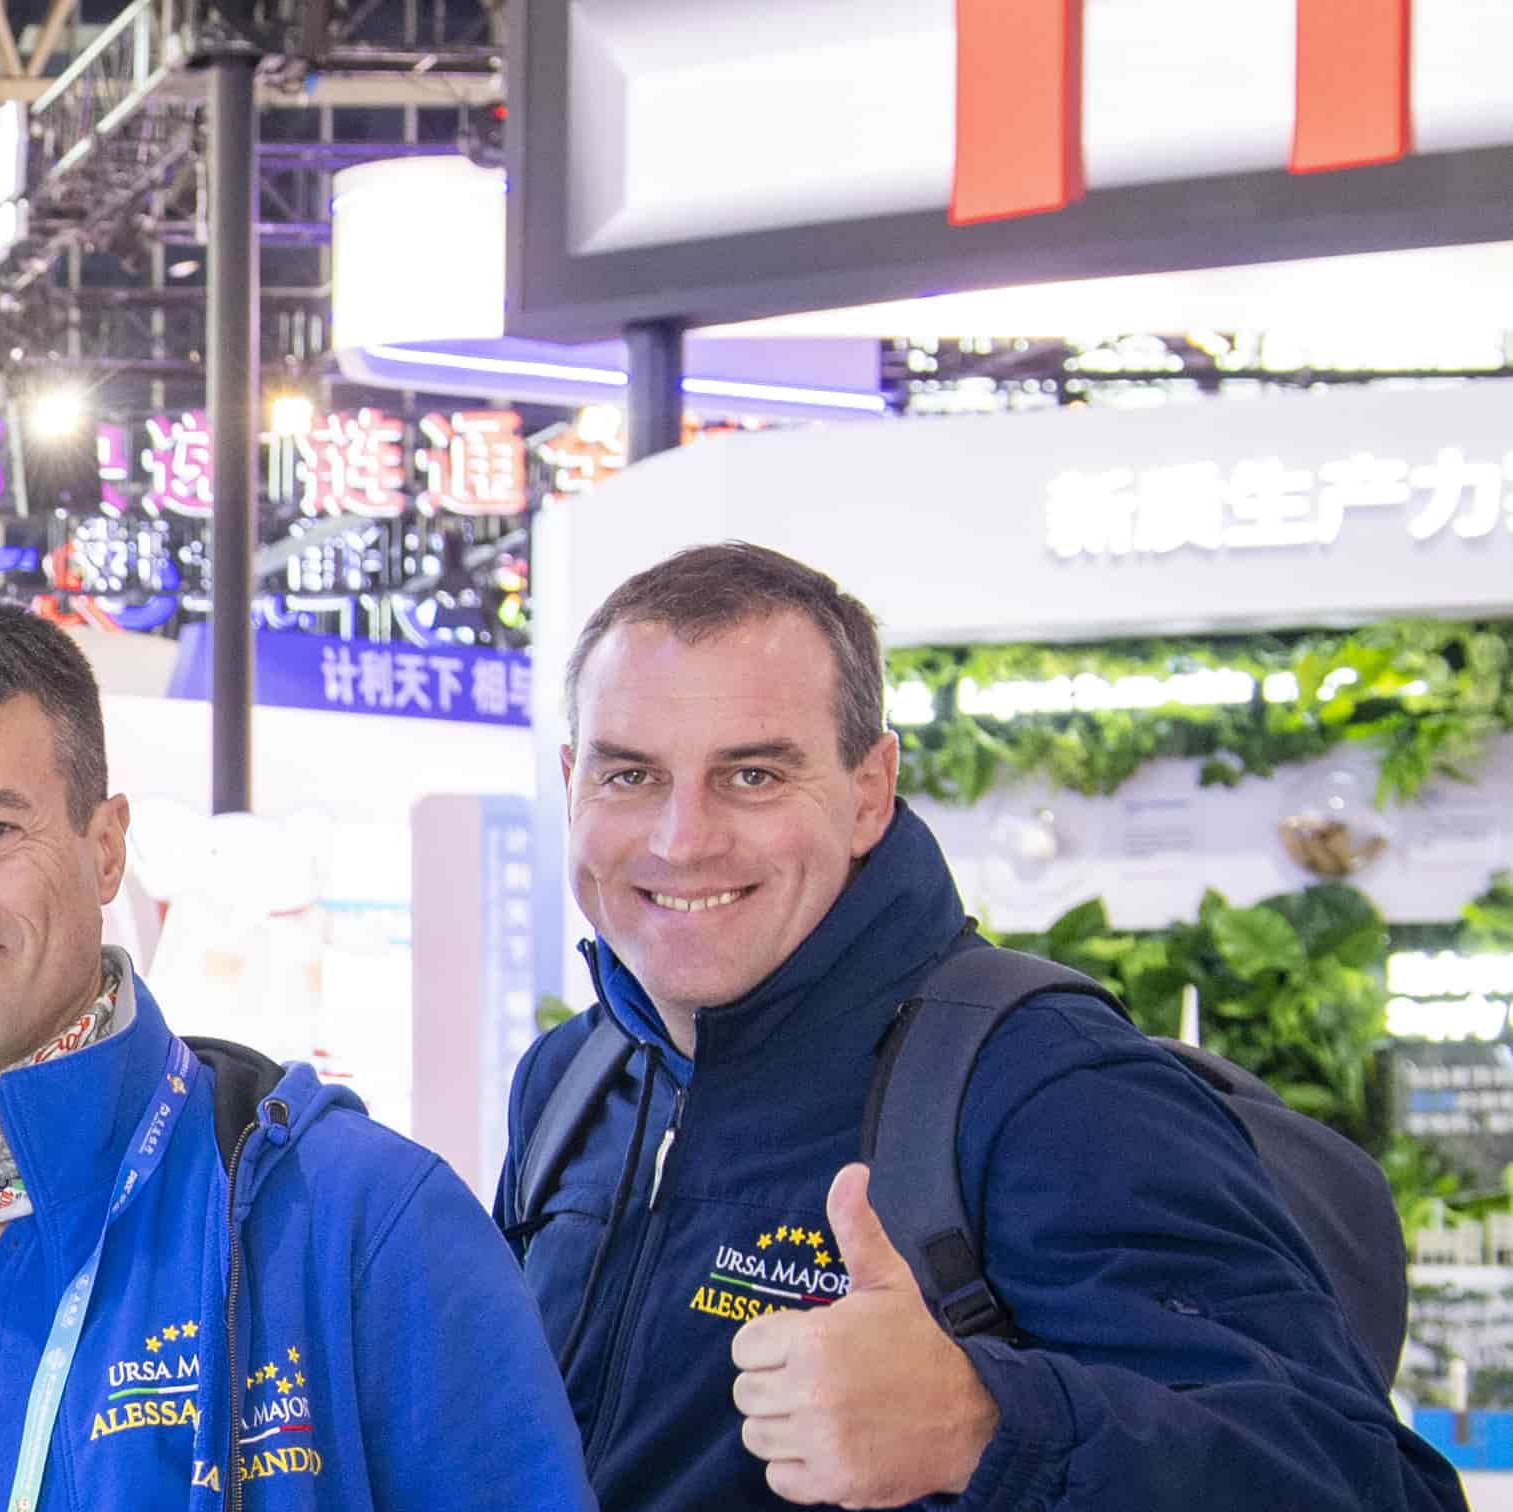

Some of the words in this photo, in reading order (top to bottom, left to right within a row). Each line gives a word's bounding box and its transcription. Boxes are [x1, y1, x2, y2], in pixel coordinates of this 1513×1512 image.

[1046, 447, 1513, 558] 新质生产力
[716, 1245, 768, 1280] URSA
[771, 1259, 853, 1295] MAJOR
[689, 1285, 788, 1325] ALESS
[108, 1358, 172, 1387] URSA
[90, 1399, 199, 1441] ALESSA
